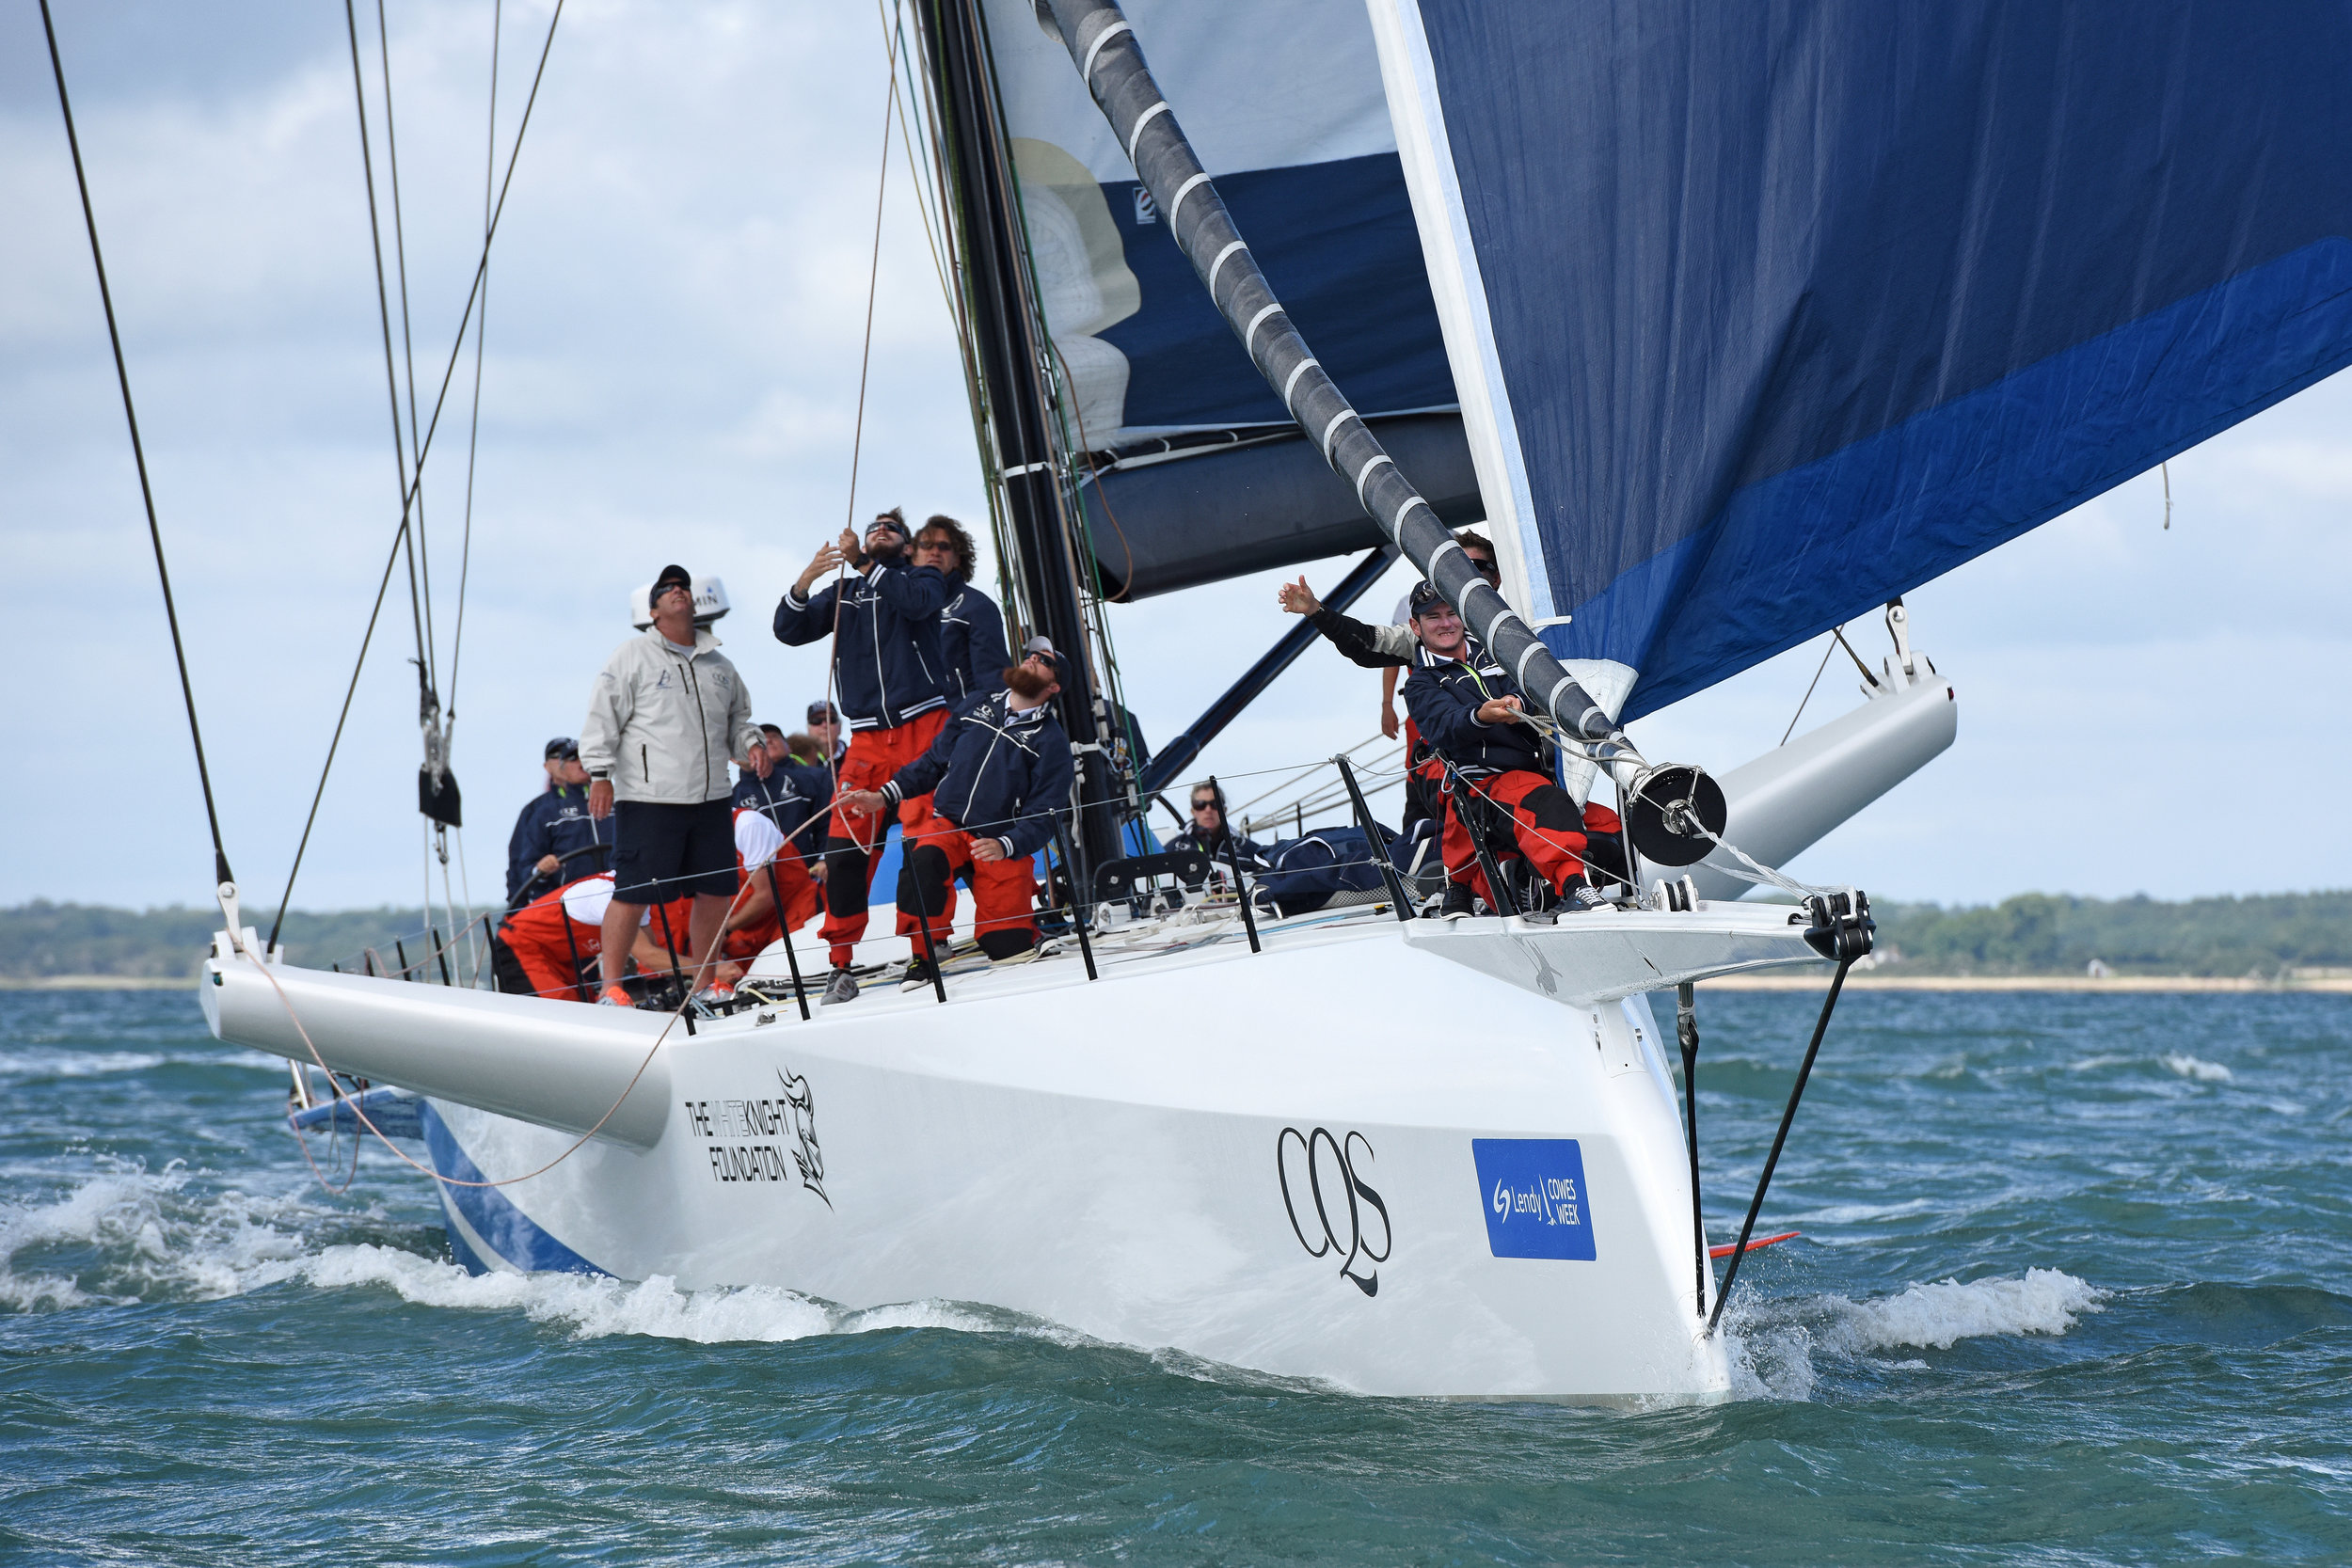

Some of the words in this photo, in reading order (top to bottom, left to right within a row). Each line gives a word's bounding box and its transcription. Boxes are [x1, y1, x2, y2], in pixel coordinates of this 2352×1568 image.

[709, 1145, 787, 1181] FOUNDATION
[1510, 1184, 1542, 1222] Lendy
[1548, 1178, 1577, 1200] COWES
[1277, 1127, 1392, 1298] CQS
[1555, 1204, 1581, 1226] WEEK
